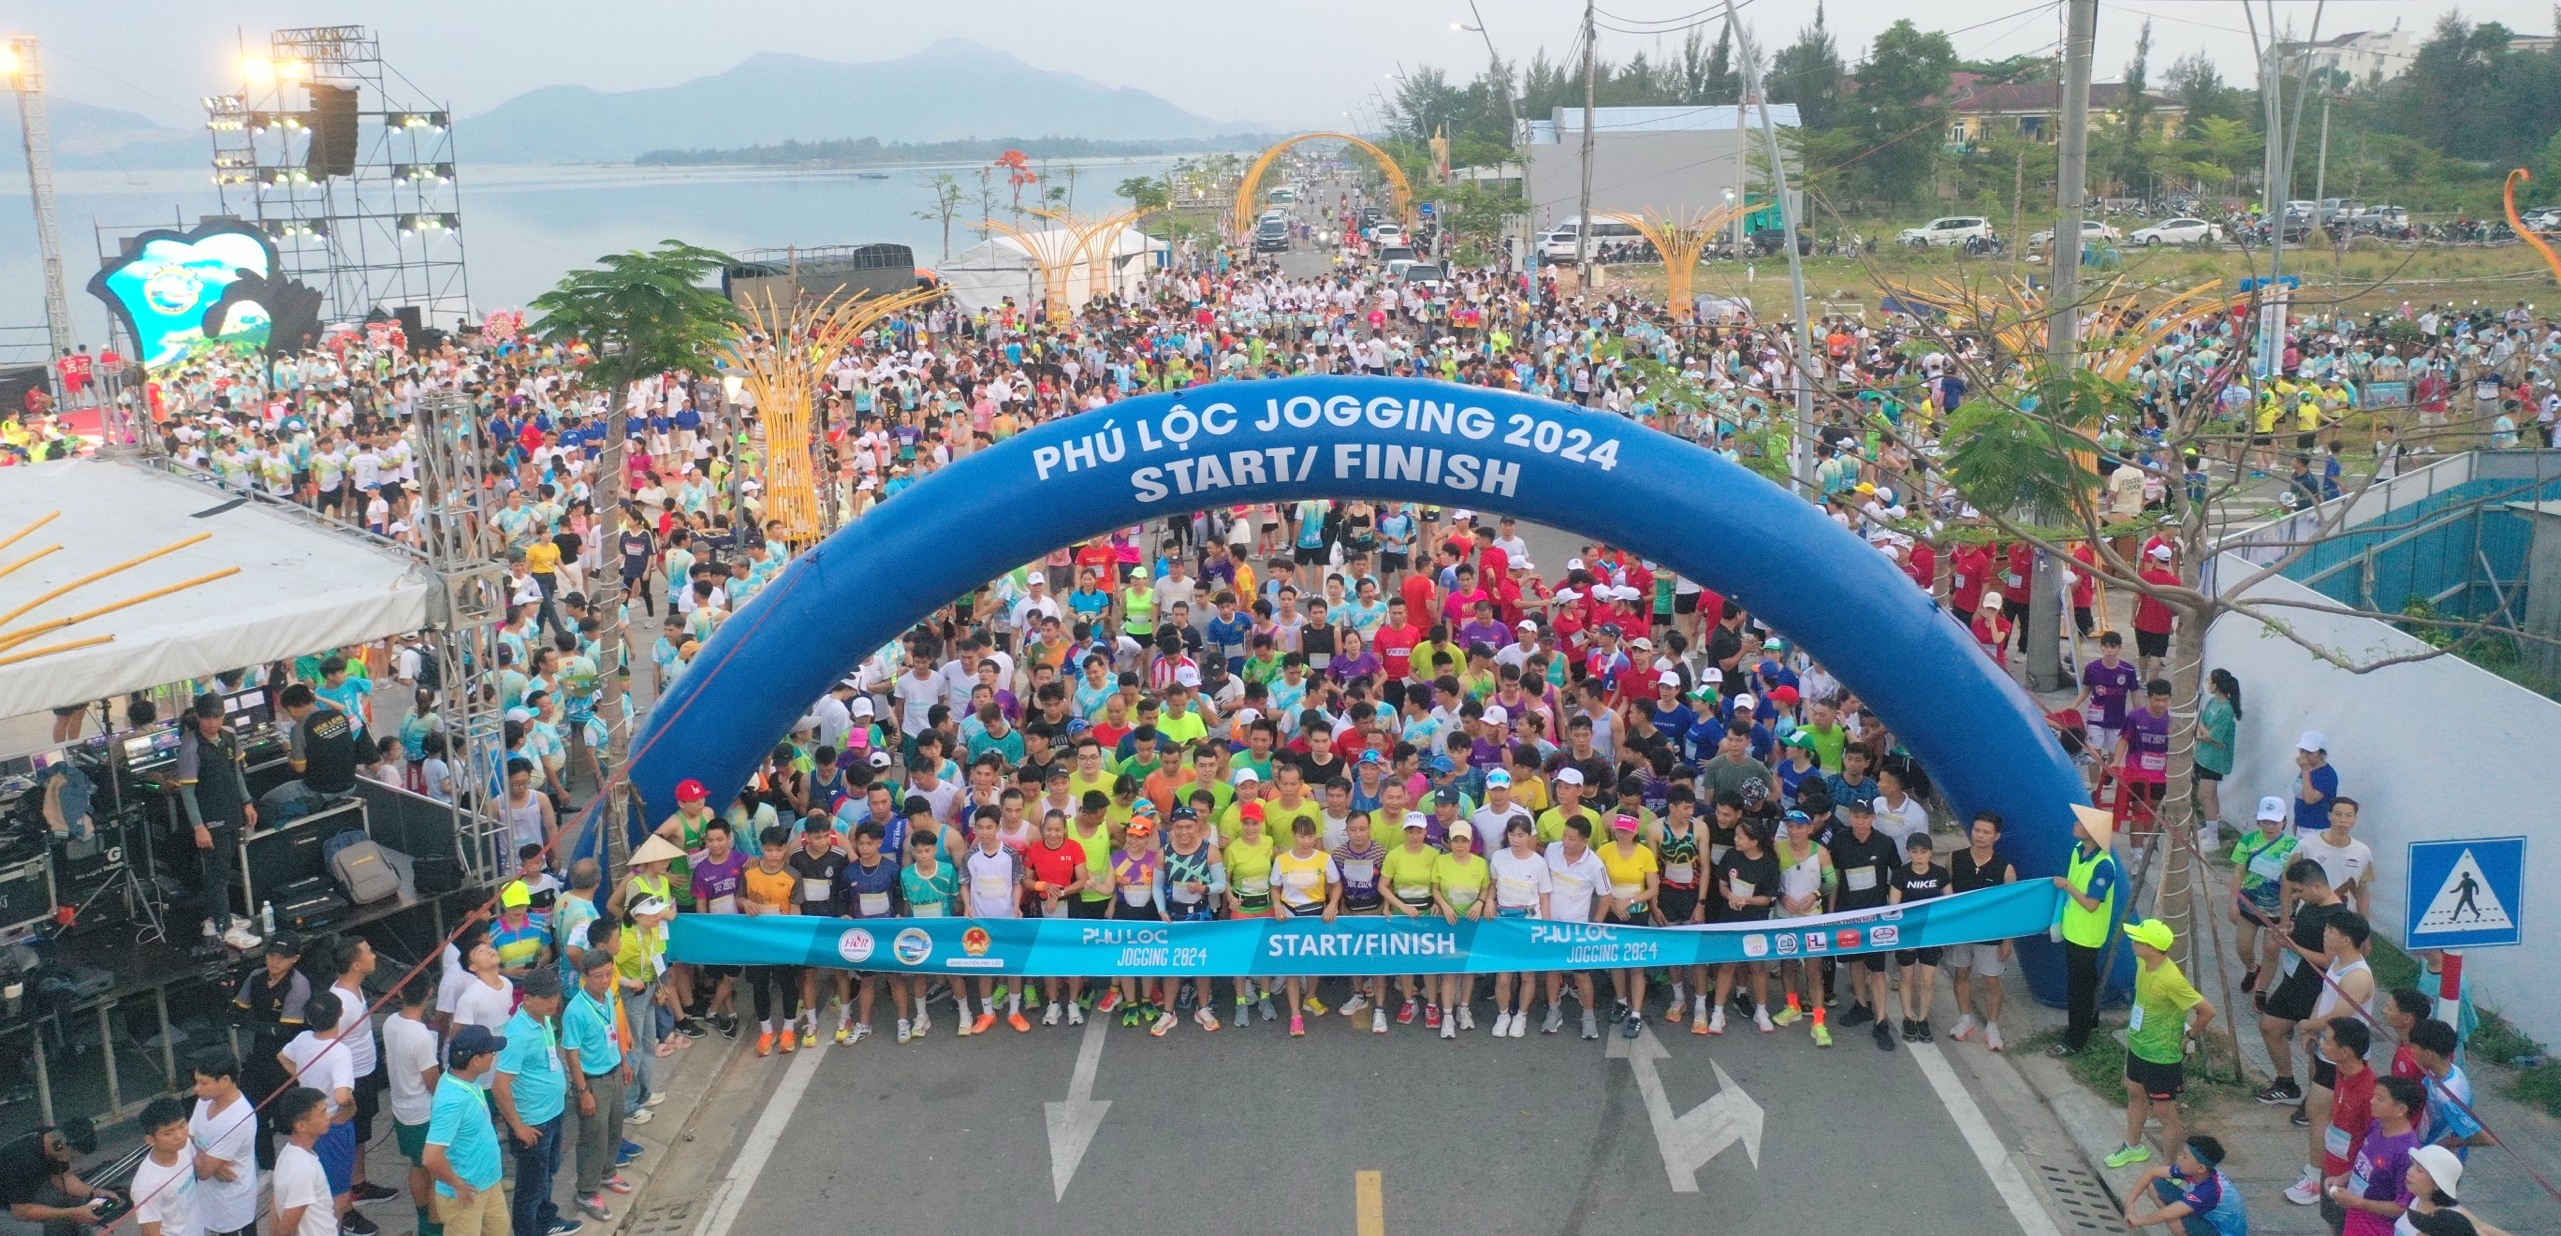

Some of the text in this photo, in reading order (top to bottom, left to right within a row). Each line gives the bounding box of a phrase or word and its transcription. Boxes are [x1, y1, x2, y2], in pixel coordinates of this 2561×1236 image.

[1032, 395, 1621, 481] PHÚ LỘC JOGGING 2024
[1130, 443, 1522, 503] START/ FINISH
[1906, 878, 1938, 889] NIKE
[1268, 932, 1456, 957] START/FINISH
[1566, 941, 1658, 964] JOGGING 2024
[1117, 947, 1208, 967] JOGGING 2024
